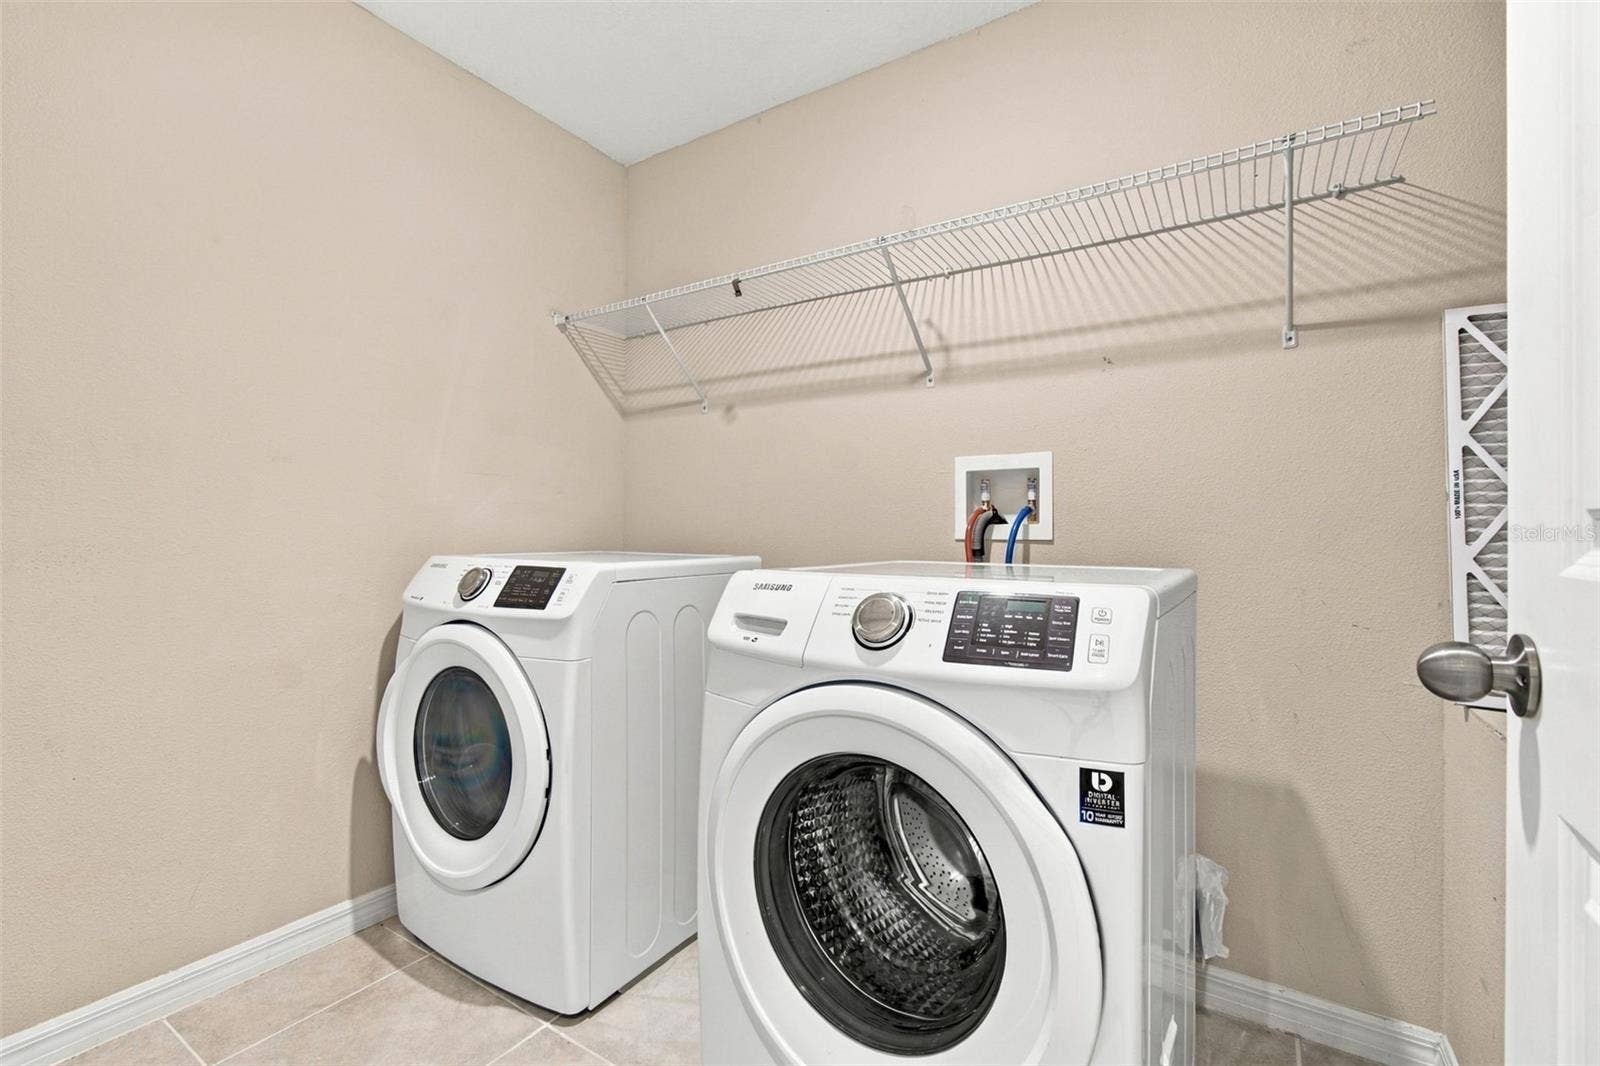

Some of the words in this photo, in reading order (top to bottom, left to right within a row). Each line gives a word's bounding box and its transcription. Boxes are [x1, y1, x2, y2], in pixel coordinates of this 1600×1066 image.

[753, 583, 793, 592] SAMSUNG
[1088, 791, 1116, 800] DIGITAL
[1084, 797, 1120, 807] INVERTER
[1081, 810, 1094, 822] 10
